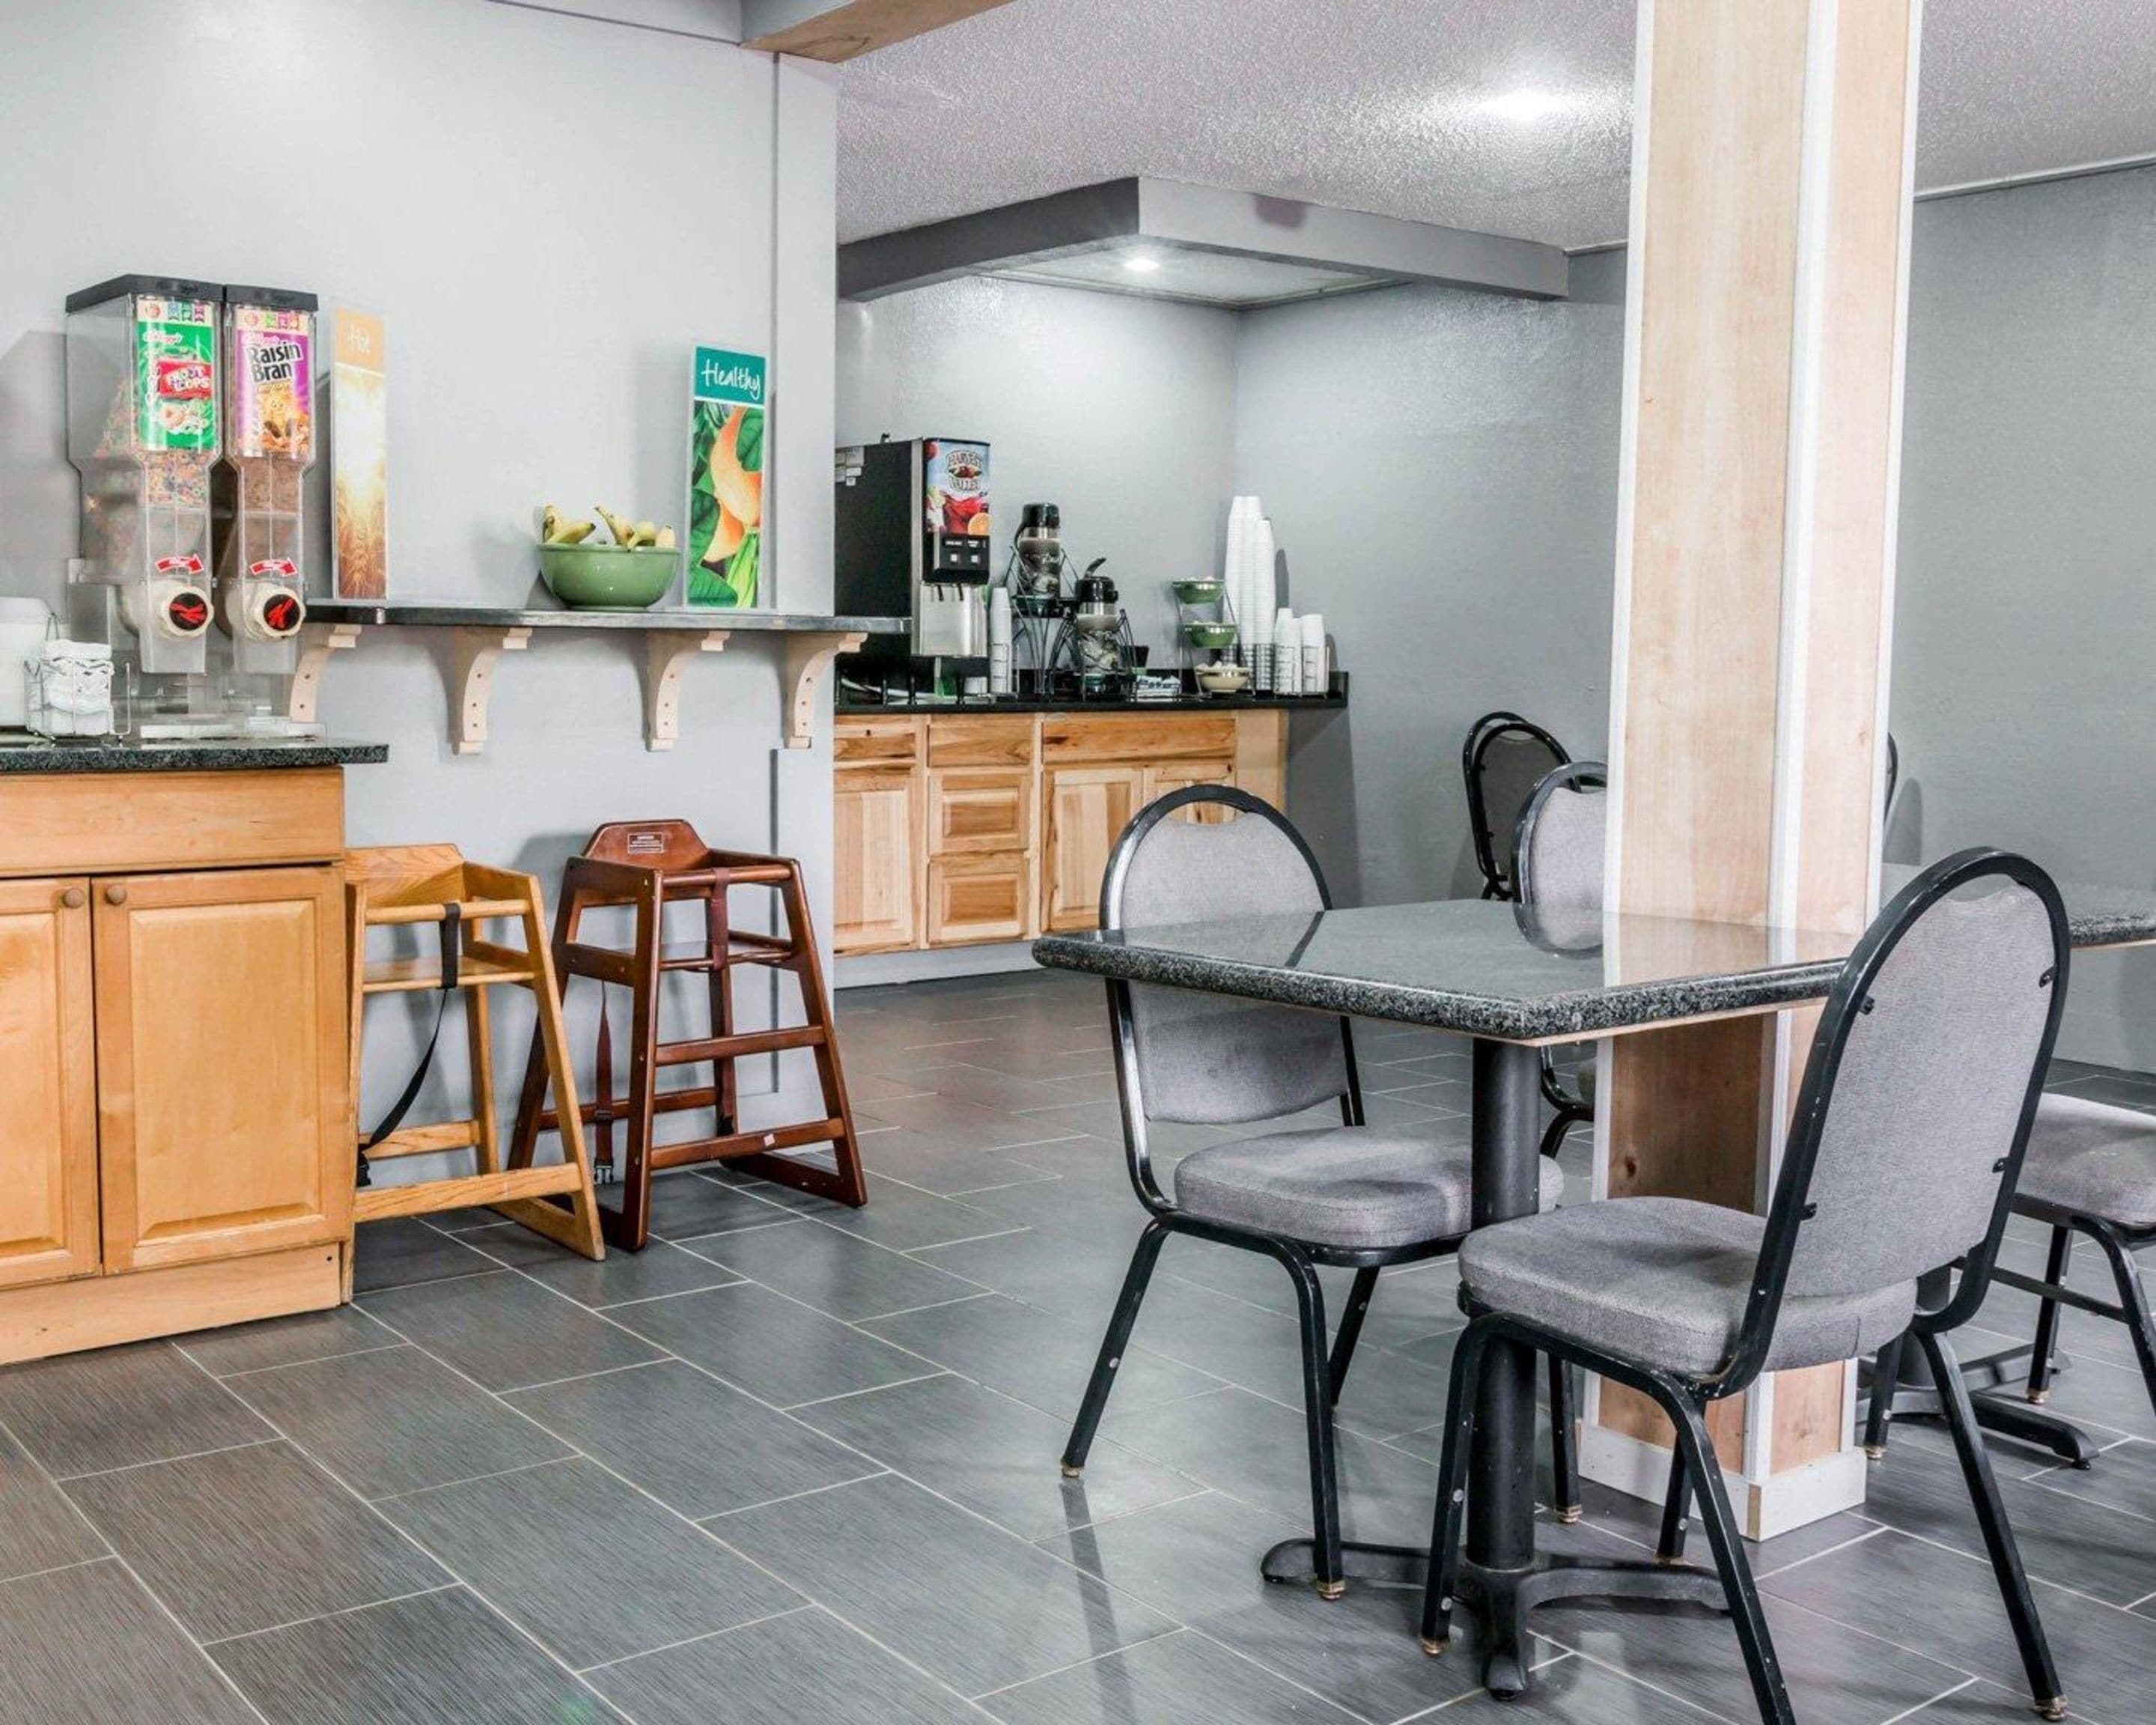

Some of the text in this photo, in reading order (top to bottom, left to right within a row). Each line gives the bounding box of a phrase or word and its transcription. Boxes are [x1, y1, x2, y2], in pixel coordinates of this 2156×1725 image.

[246, 341, 301, 364] Raisin
[252, 362, 293, 383] Bran
[701, 359, 761, 401] Healthy
